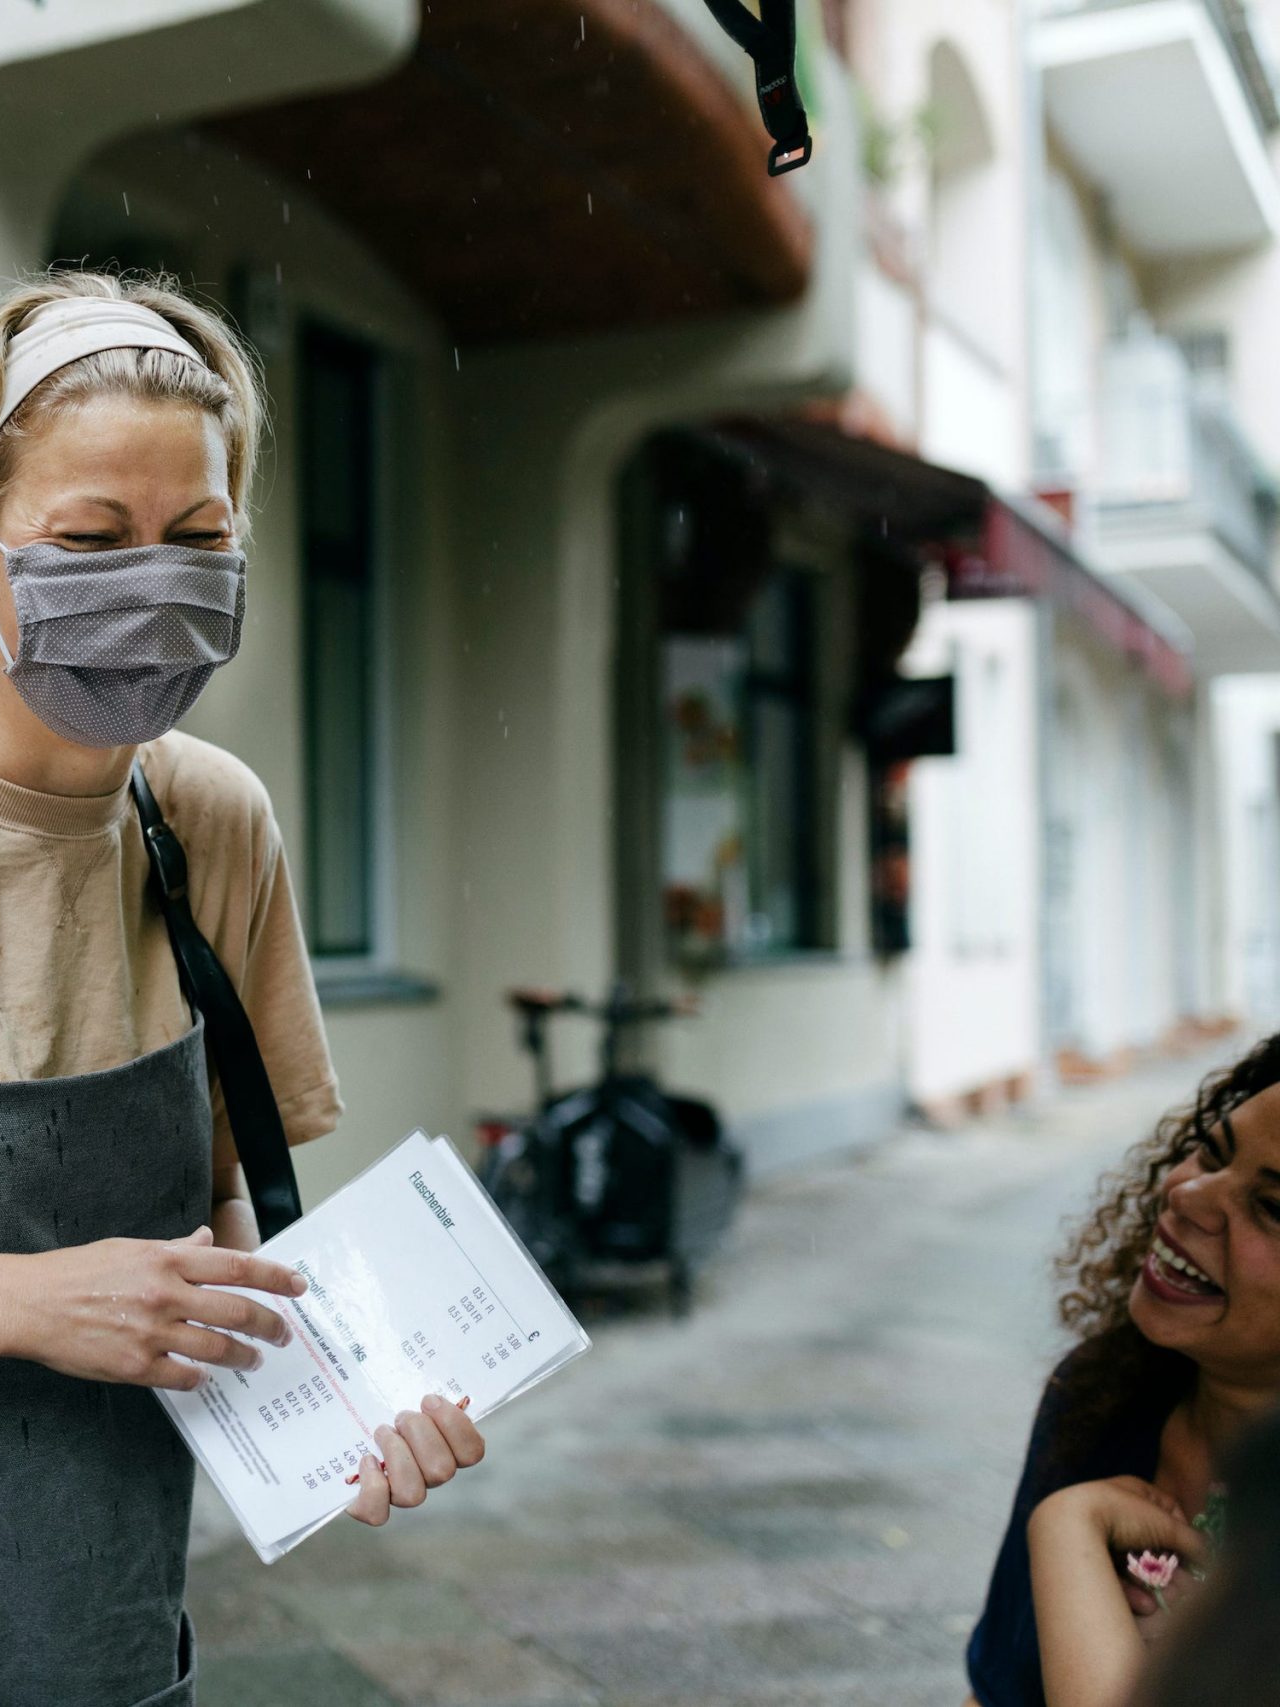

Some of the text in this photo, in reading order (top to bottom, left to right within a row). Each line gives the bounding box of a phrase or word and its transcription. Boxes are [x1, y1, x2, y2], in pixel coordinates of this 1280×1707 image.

[409, 1170, 455, 1228] Flaschenbier
[333, 1312, 367, 1362] Softdrinks
[412, 1330, 425, 1344] 0,5
[447, 1304, 460, 1318] 0,5
[480, 1351, 496, 1369] 3,50
[459, 1295, 475, 1312] 0,33
[493, 1342, 510, 1360] 2,80
[472, 1286, 485, 1299] 0,5
[505, 1332, 521, 1350] 3,00
[527, 1330, 540, 1341] €
[310, 1374, 325, 1391] 0,33
[316, 1336, 330, 1352] Laut
[326, 1351, 338, 1364] oder
[335, 1363, 349, 1381] Leise
[271, 1397, 284, 1410] 0,2
[315, 1464, 331, 1481] 2,20
[284, 1390, 297, 1403] 0,2
[328, 1456, 344, 1473] 2,20
[297, 1382, 313, 1399] 0,75
[342, 1449, 357, 1466] 4,90
[301, 1472, 317, 1489] 2,80
